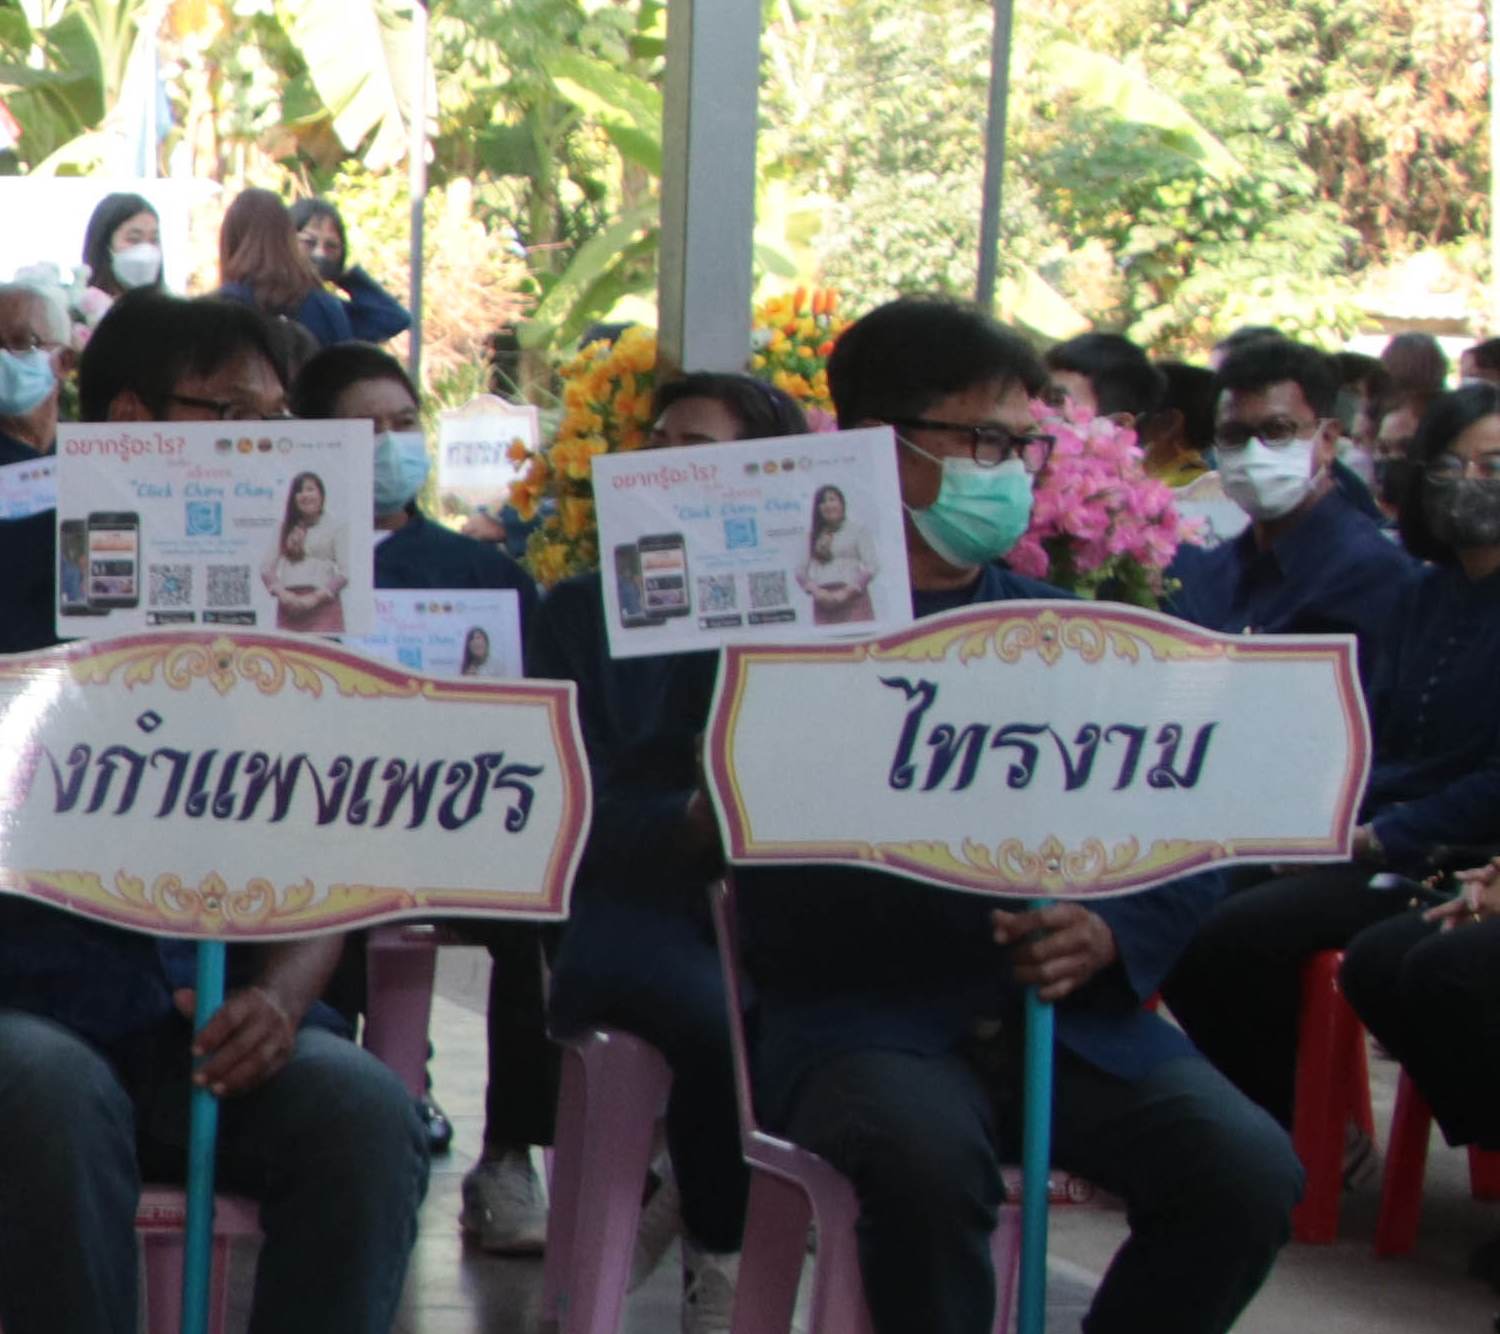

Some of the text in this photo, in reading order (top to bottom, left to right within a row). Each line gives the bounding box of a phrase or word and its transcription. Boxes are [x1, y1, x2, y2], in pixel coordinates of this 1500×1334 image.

[65, 432, 186, 463] อยากรู้อะไร?
[880, 674, 1218, 794] ไทรงาม
